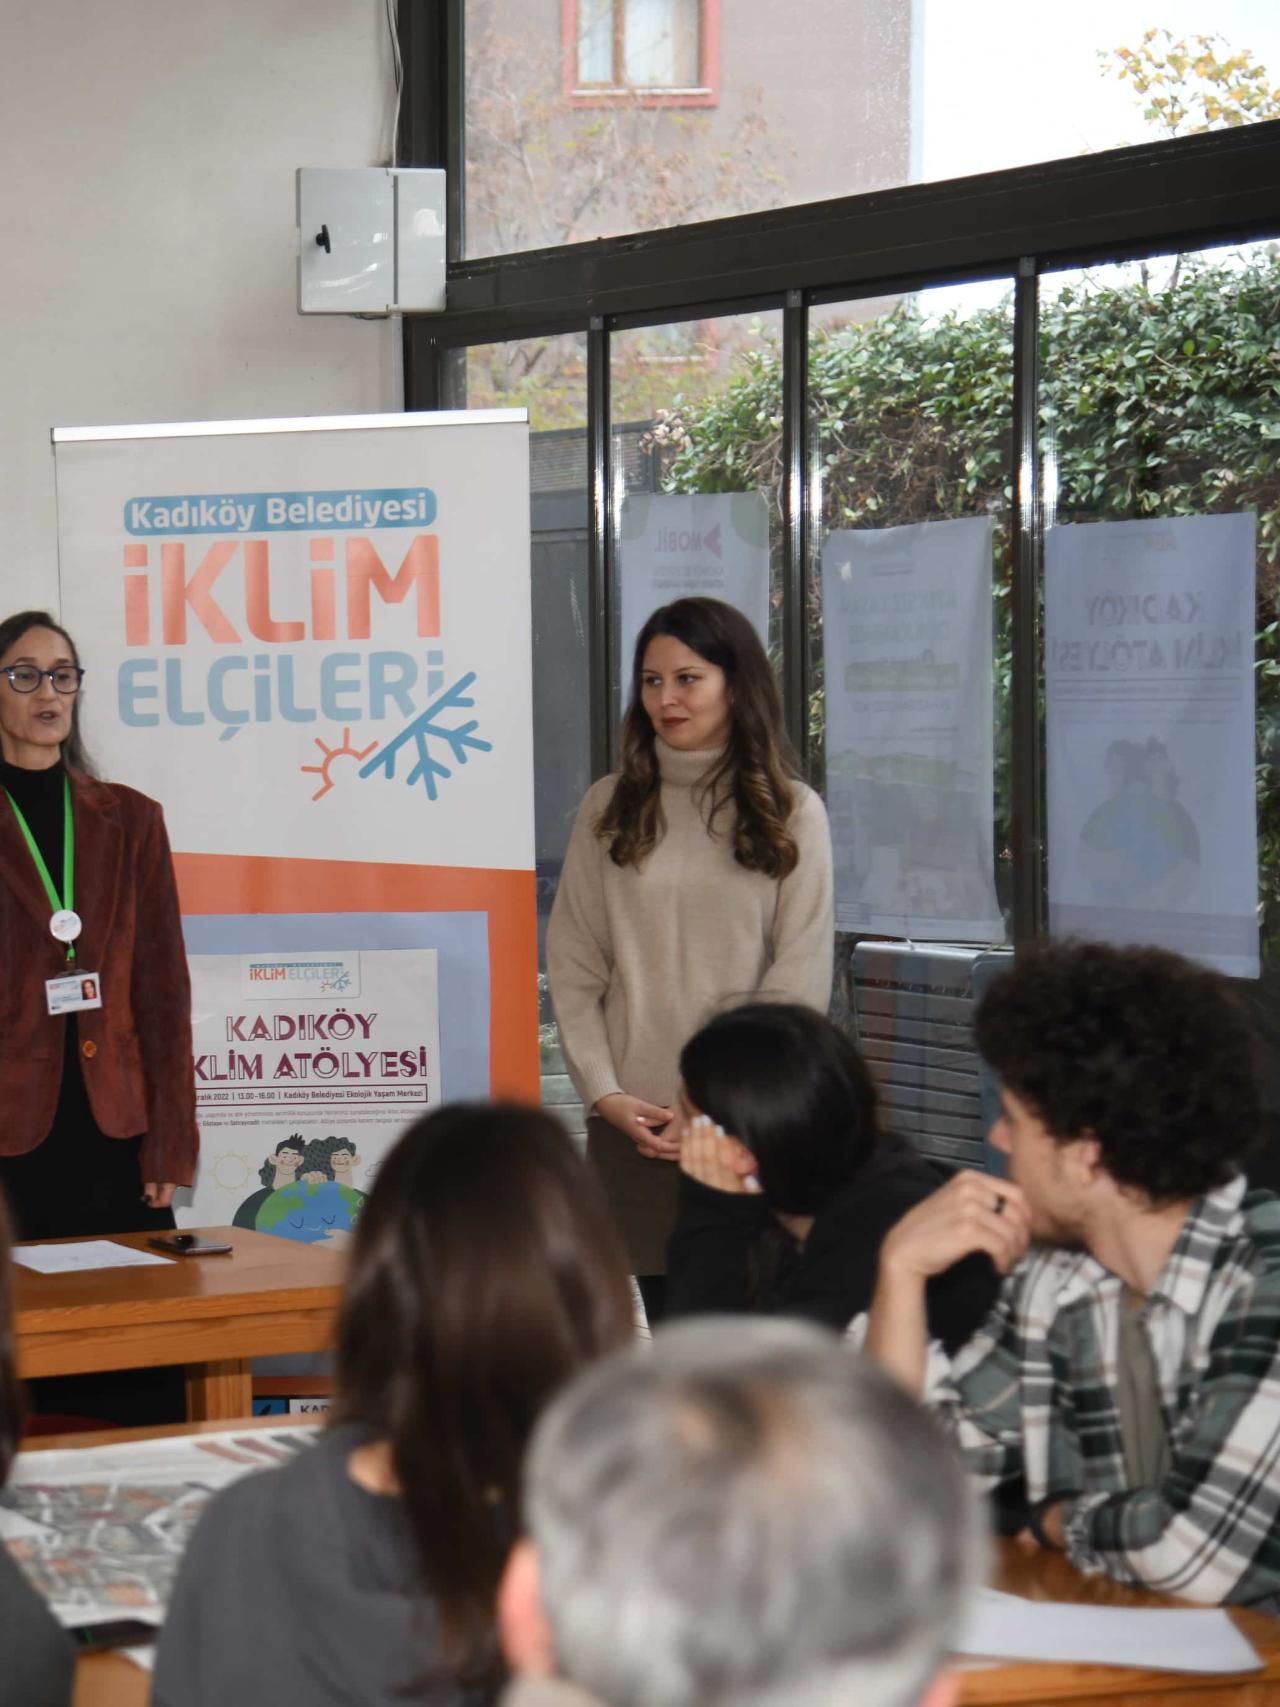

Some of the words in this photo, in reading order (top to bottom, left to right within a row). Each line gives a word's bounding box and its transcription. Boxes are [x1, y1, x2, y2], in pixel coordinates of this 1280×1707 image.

[131, 497, 256, 532] Kadıköy
[266, 492, 427, 527] Belediyesi
[123, 534, 441, 647] İKLİM
[117, 650, 445, 742] ELÇİLERİ
[249, 967, 287, 981] İKLİM
[226, 1008, 378, 1042] KADIKÖY
[193, 1049, 263, 1081] KLİM
[273, 1046, 428, 1080] ATÖLYESİ
[195, 1092, 211, 1101] ralık
[213, 1092, 229, 1101] 2022
[283, 1091, 310, 1101] Kadıköy
[311, 1090, 345, 1099] Belediyesi
[346, 1089, 372, 1099] Ekolojik
[373, 1089, 396, 1098] Yaşam
[397, 1088, 424, 1097] Merkezi
